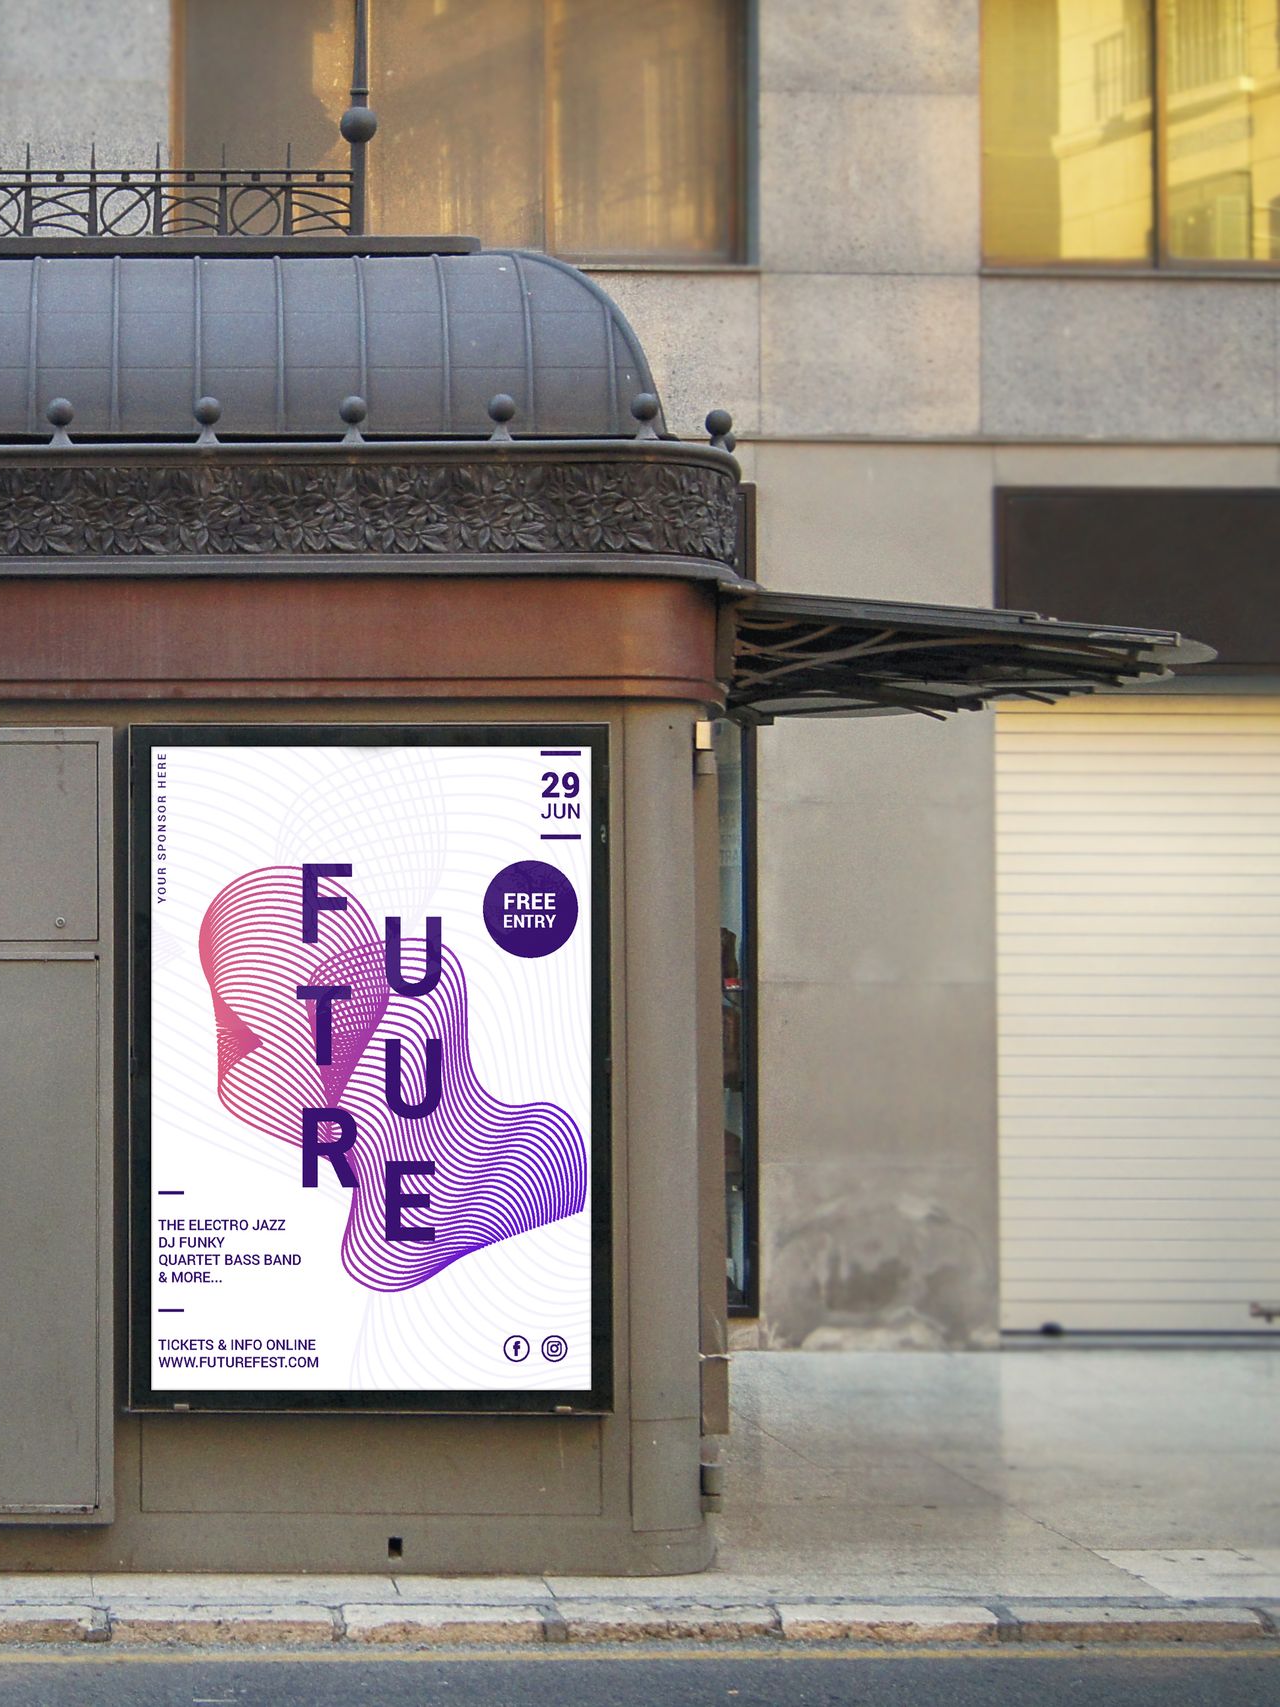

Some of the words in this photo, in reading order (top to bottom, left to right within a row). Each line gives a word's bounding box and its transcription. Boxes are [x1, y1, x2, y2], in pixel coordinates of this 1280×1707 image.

[157, 753, 167, 788] HERE
[541, 771, 580, 798] 29
[541, 803, 580, 820] JUN
[157, 795, 167, 861] SPONSOR
[157, 868, 167, 904] YOUR
[503, 893, 556, 910] FREE
[503, 914, 557, 929] ENTRY
[158, 1219, 185, 1231] THE
[189, 1219, 249, 1231] ELECTRO
[252, 1219, 286, 1231] JAZZ
[158, 1236, 176, 1249] DJ
[179, 1236, 225, 1249] FUNKY
[158, 1254, 221, 1267] QUARTET
[224, 1254, 260, 1266] BASS
[264, 1254, 302, 1266] BAND
[158, 1271, 168, 1283] &
[171, 1271, 223, 1284] MORE...
[158, 1339, 214, 1351] TICKETS
[218, 1339, 228, 1351] &
[231, 1339, 263, 1351] INFO
[266, 1339, 316, 1351] ONLINE
[158, 1356, 319, 1369] WWW.FUTUREFEST.COM
